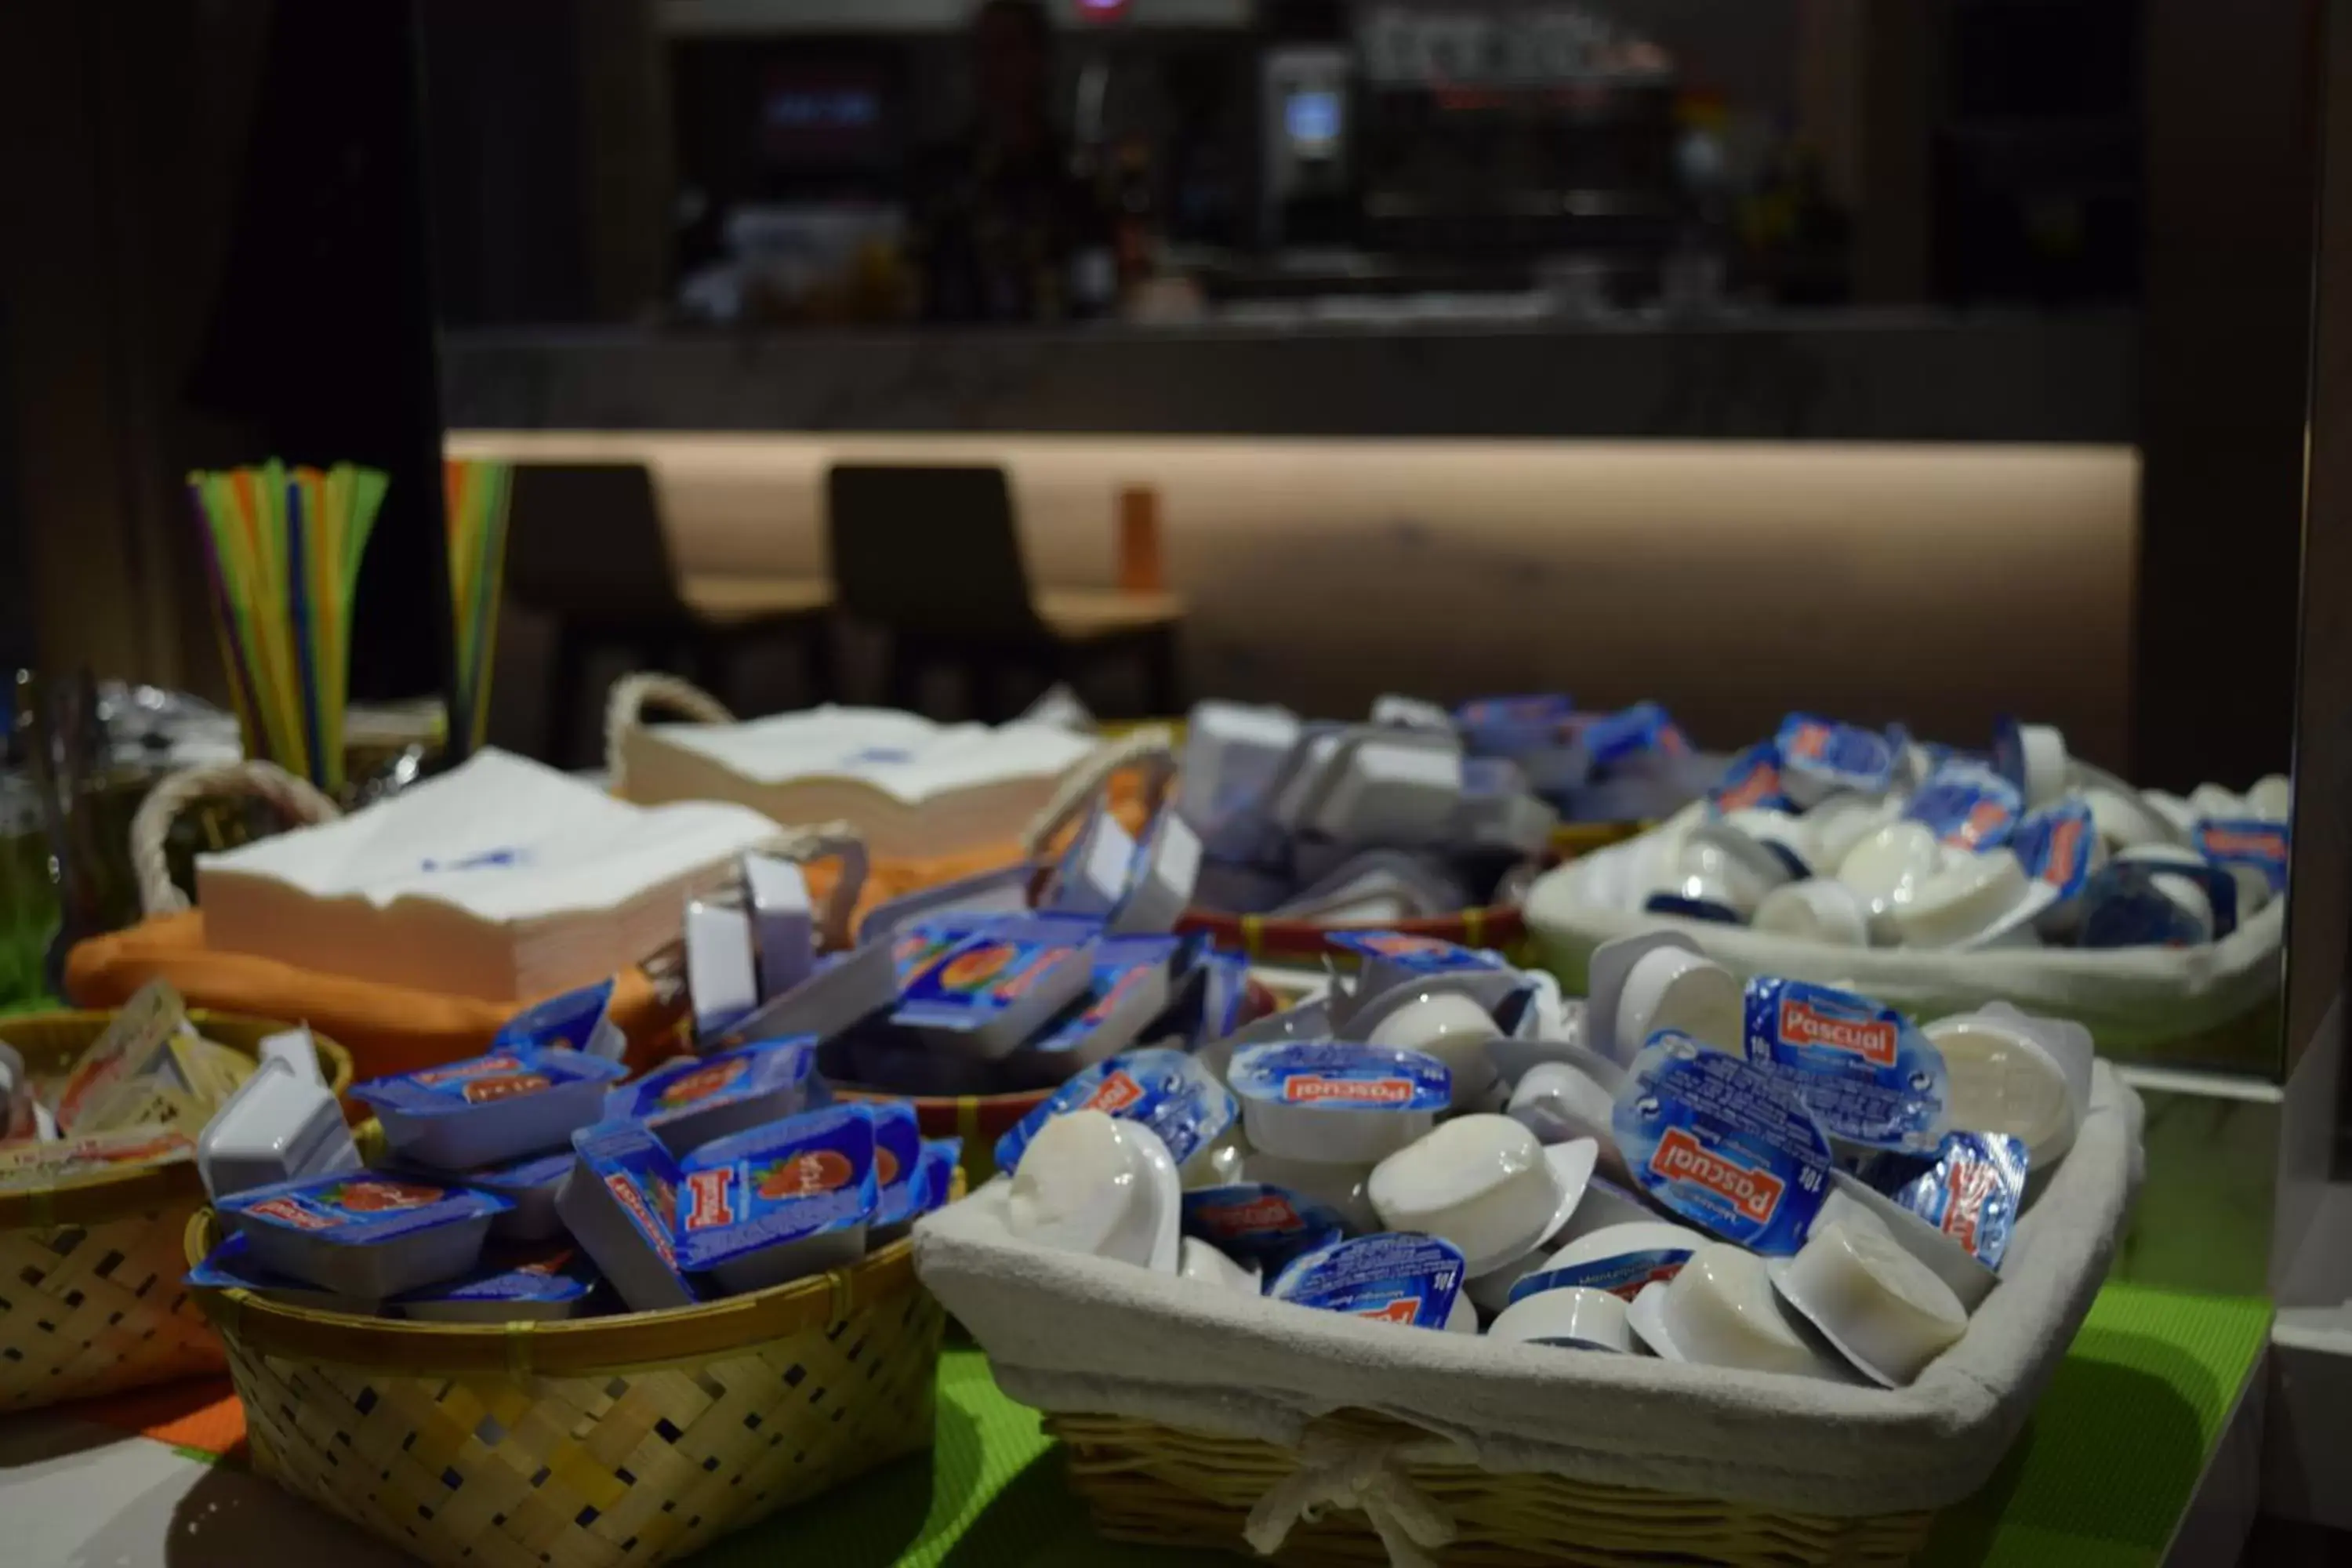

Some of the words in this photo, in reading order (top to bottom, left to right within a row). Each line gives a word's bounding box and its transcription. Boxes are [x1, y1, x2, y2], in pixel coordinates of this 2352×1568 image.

[1787, 1010, 1886, 1052] Pascual
[1296, 1082, 1407, 1102] Pascual
[1663, 1144, 1773, 1214] Pascual
